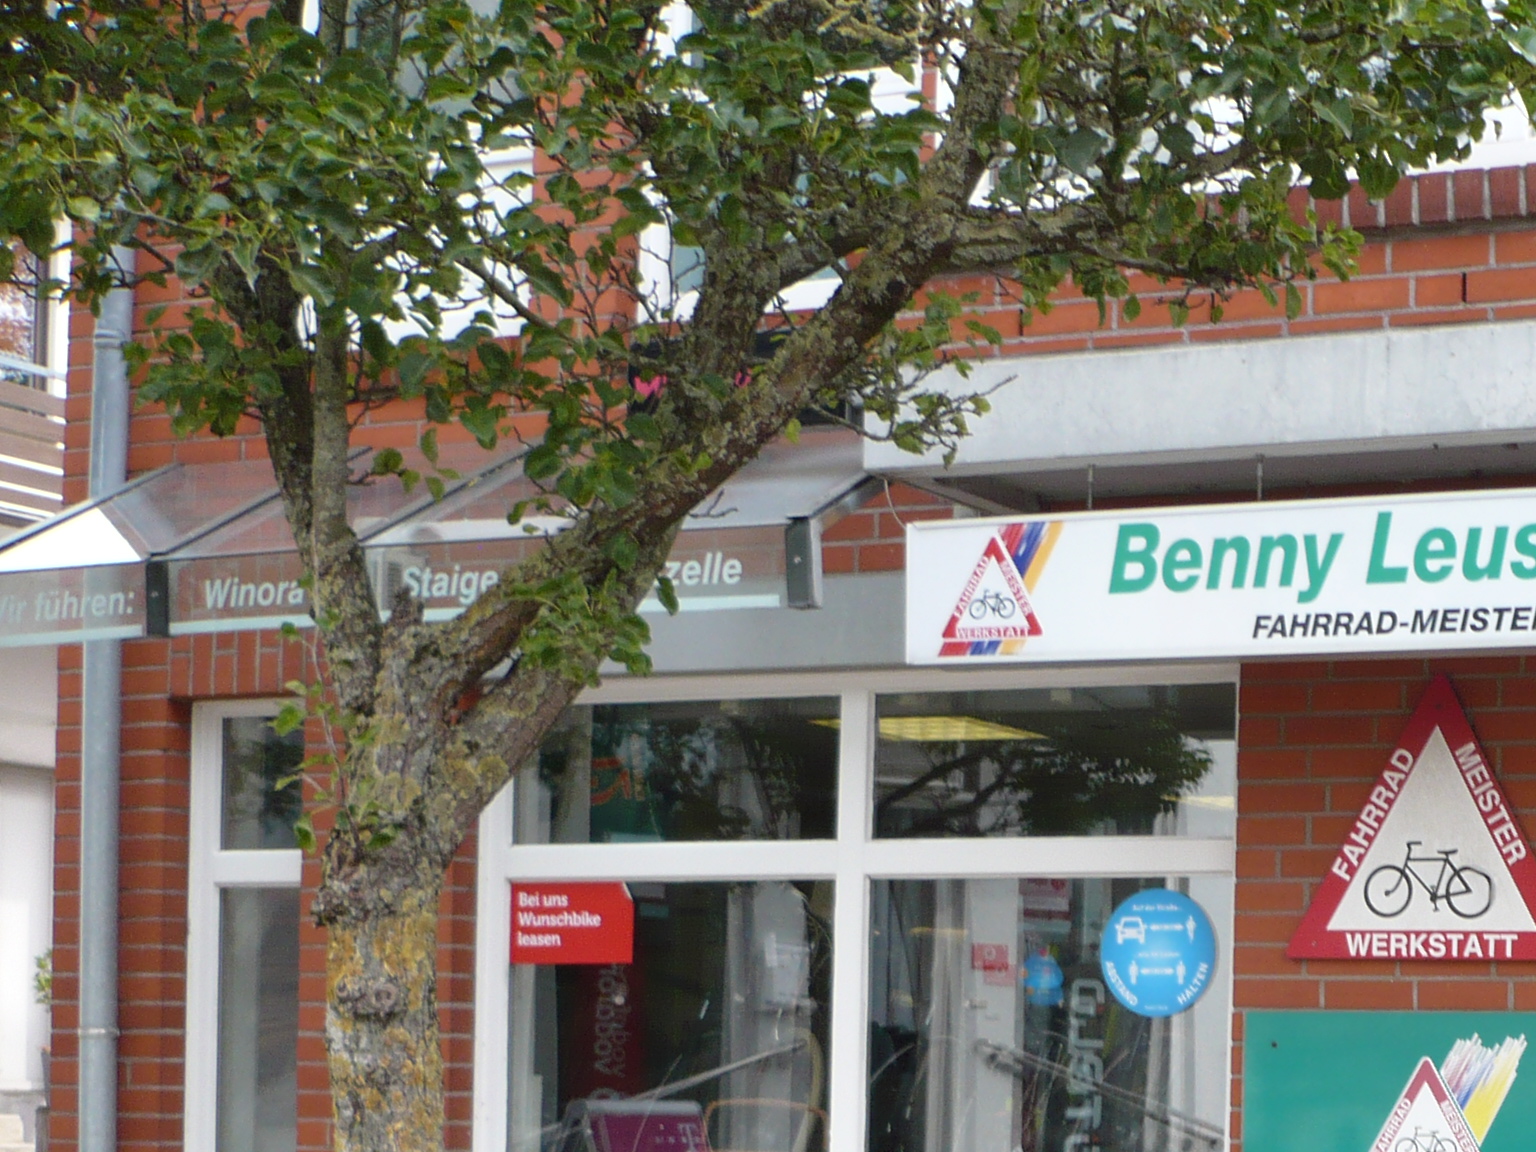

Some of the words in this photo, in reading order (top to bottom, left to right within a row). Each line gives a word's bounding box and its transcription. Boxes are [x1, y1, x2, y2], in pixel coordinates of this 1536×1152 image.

[652, 552, 743, 586] zelle
[1108, 522, 1346, 603] Benny
[205, 577, 304, 609] Winora
[404, 564, 500, 606] Staige
[35, 590, 136, 621] führen:
[956, 627, 1029, 639] WERKSTATT
[1332, 747, 1415, 881] FAHRRAD
[1455, 742, 1526, 866] MEISTER
[518, 892, 540, 907] Bei
[543, 894, 568, 907] uns
[518, 911, 601, 927] Wunschbike
[518, 931, 561, 946] leasen
[1345, 932, 1518, 958] WERKSTATT
[1105, 961, 1138, 1006] ABSTAND
[1177, 962, 1209, 1005] HALTEN
